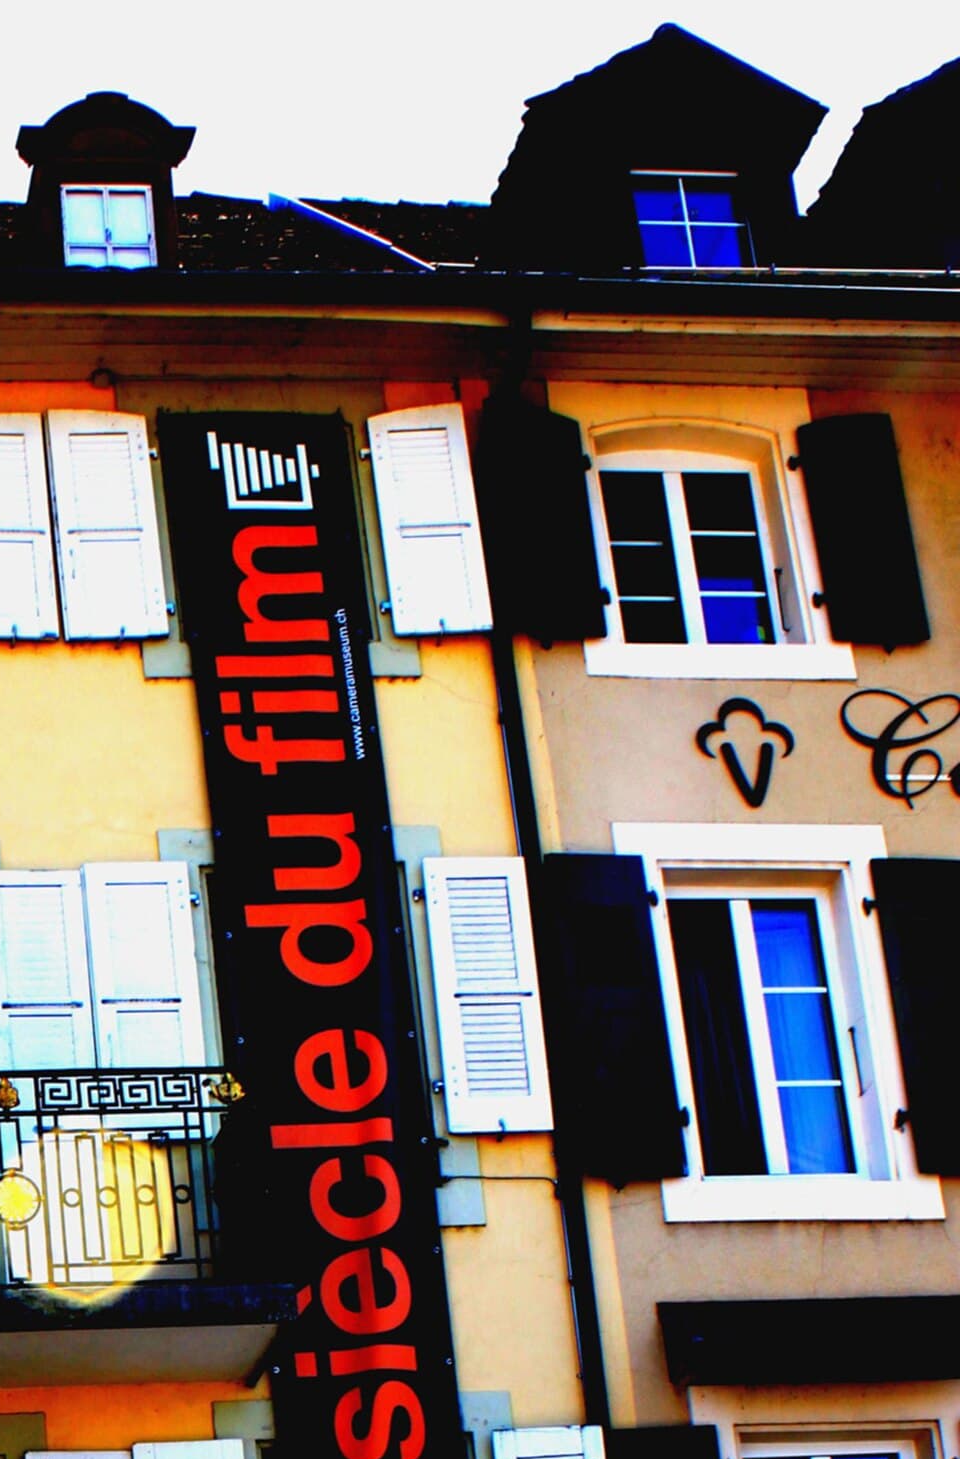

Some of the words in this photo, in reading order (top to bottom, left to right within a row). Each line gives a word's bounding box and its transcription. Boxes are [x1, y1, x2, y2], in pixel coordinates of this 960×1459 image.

[216, 525, 346, 776] film
[335, 608, 366, 760] www.cameramuseum.ch
[244, 812, 373, 987] du
